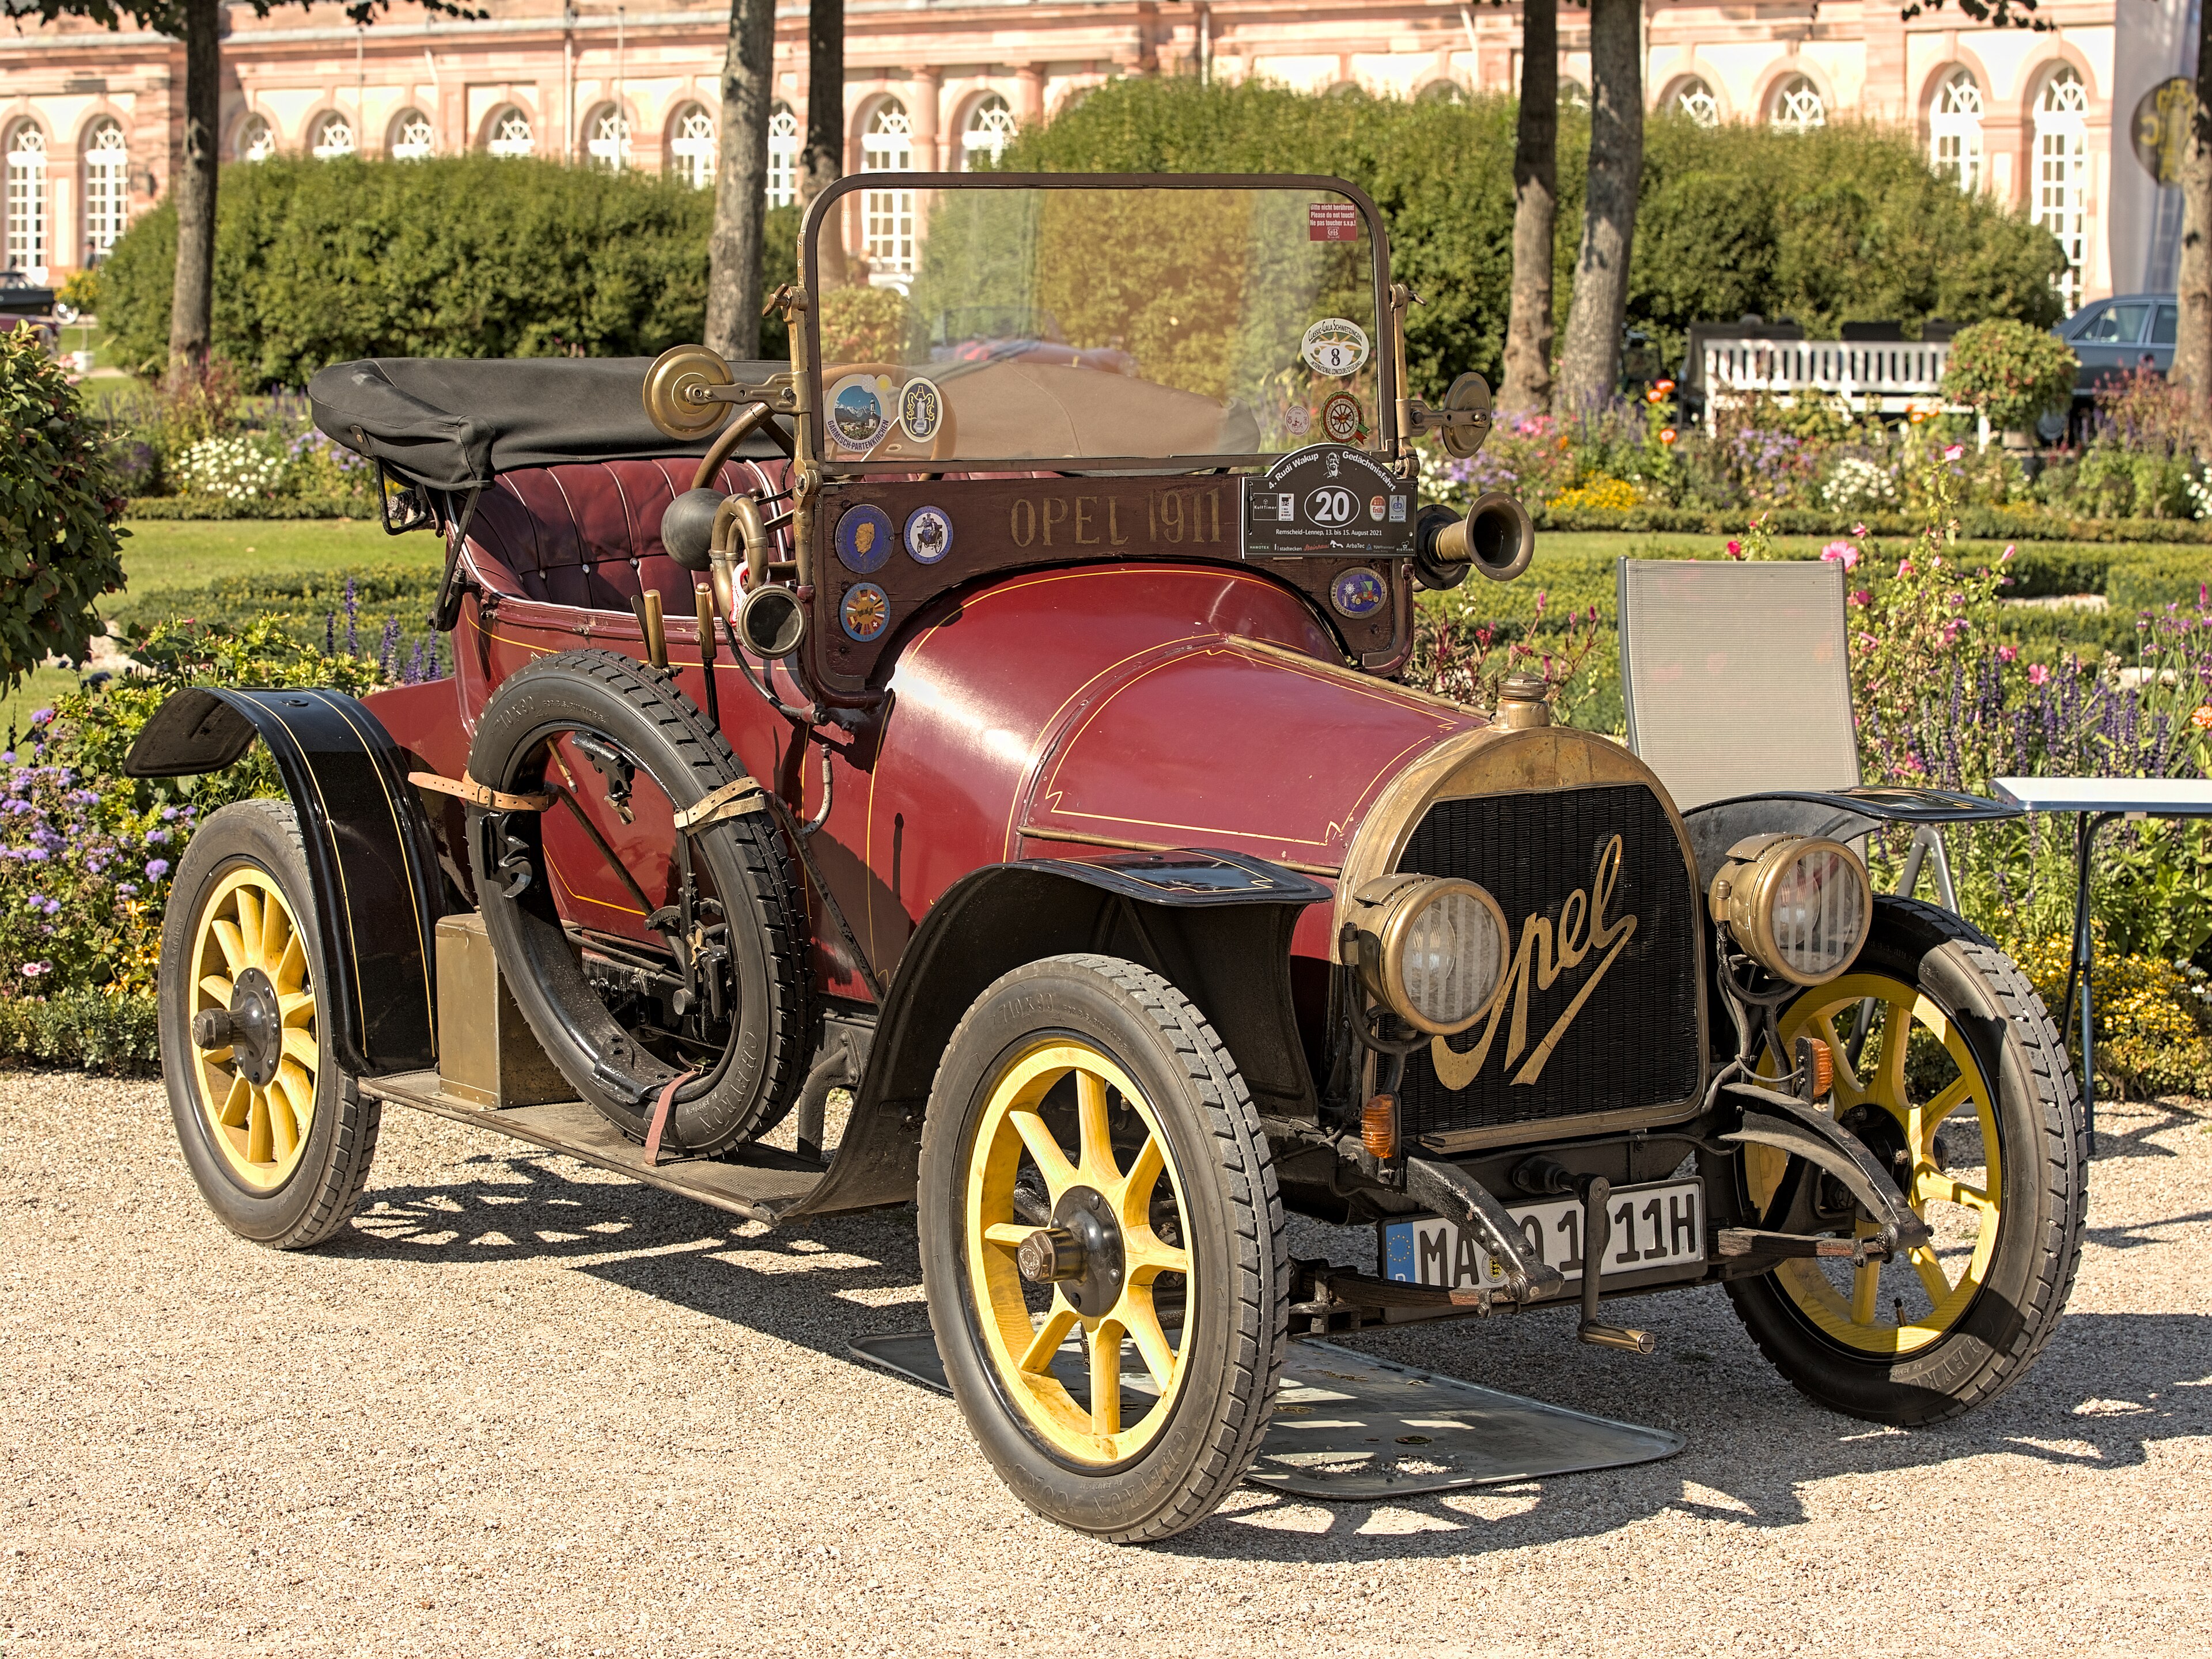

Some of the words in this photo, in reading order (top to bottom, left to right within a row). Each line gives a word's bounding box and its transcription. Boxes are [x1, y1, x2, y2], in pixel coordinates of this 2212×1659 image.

[1310, 361, 1331, 374] INTERNATIONAL
[1331, 348, 1340, 366] 8
[827, 419, 889, 450] GARMISCH-PARTENKIRCHEN
[1268, 481, 1277, 490] 4.
[1275, 464, 1293, 482] Rudi
[1292, 453, 1319, 468] Wakup
[1342, 450, 1397, 491] Gedächtnisfahrt
[1011, 497, 1128, 547] OPEL
[1149, 487, 1222, 543] 1911
[1315, 491, 1350, 521] 20
[1419, 1218, 1480, 1288] MA
[1557, 1194, 1696, 1272] 111H
